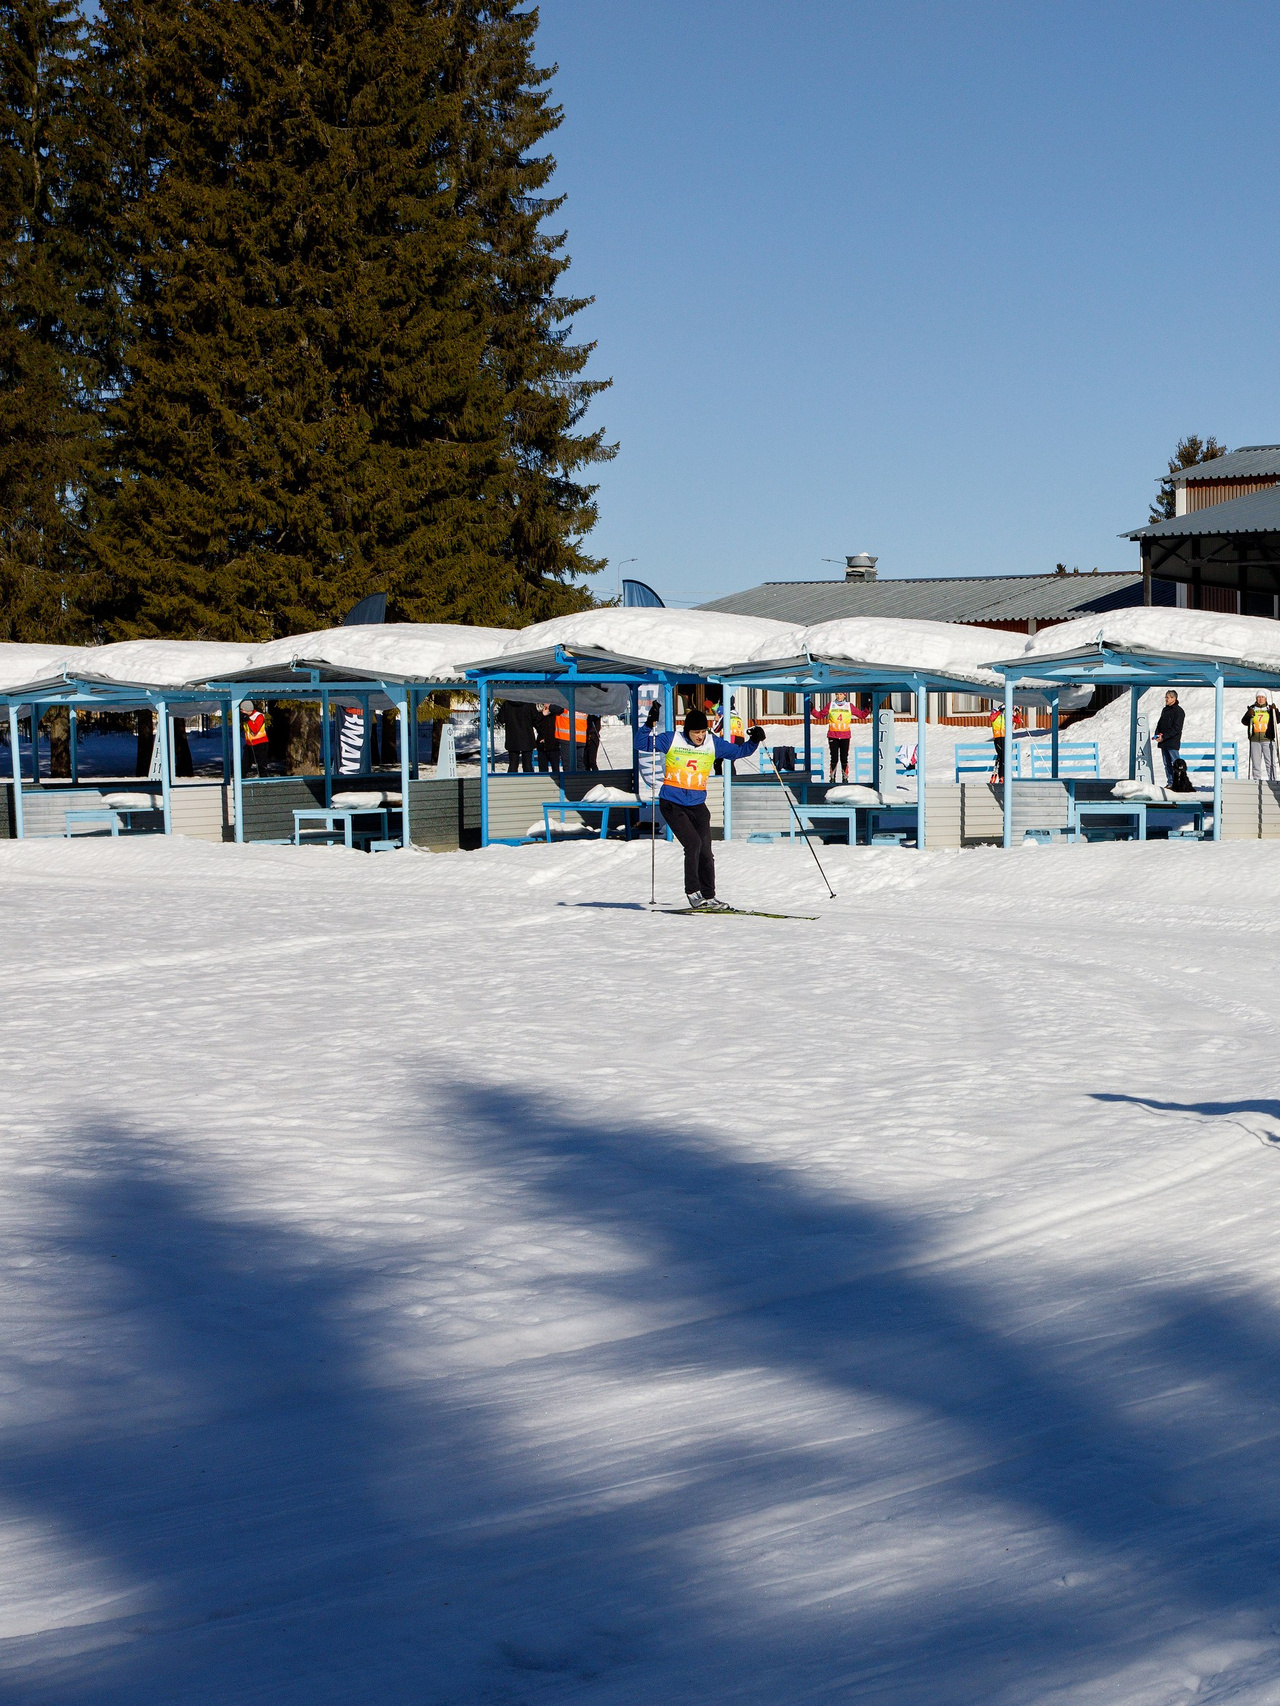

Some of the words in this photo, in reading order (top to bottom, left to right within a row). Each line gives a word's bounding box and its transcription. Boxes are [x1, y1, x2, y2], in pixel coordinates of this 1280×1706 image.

[836, 713, 843, 721] 4
[1257, 714, 1264, 722] 7
[686, 760, 698, 771] 5
